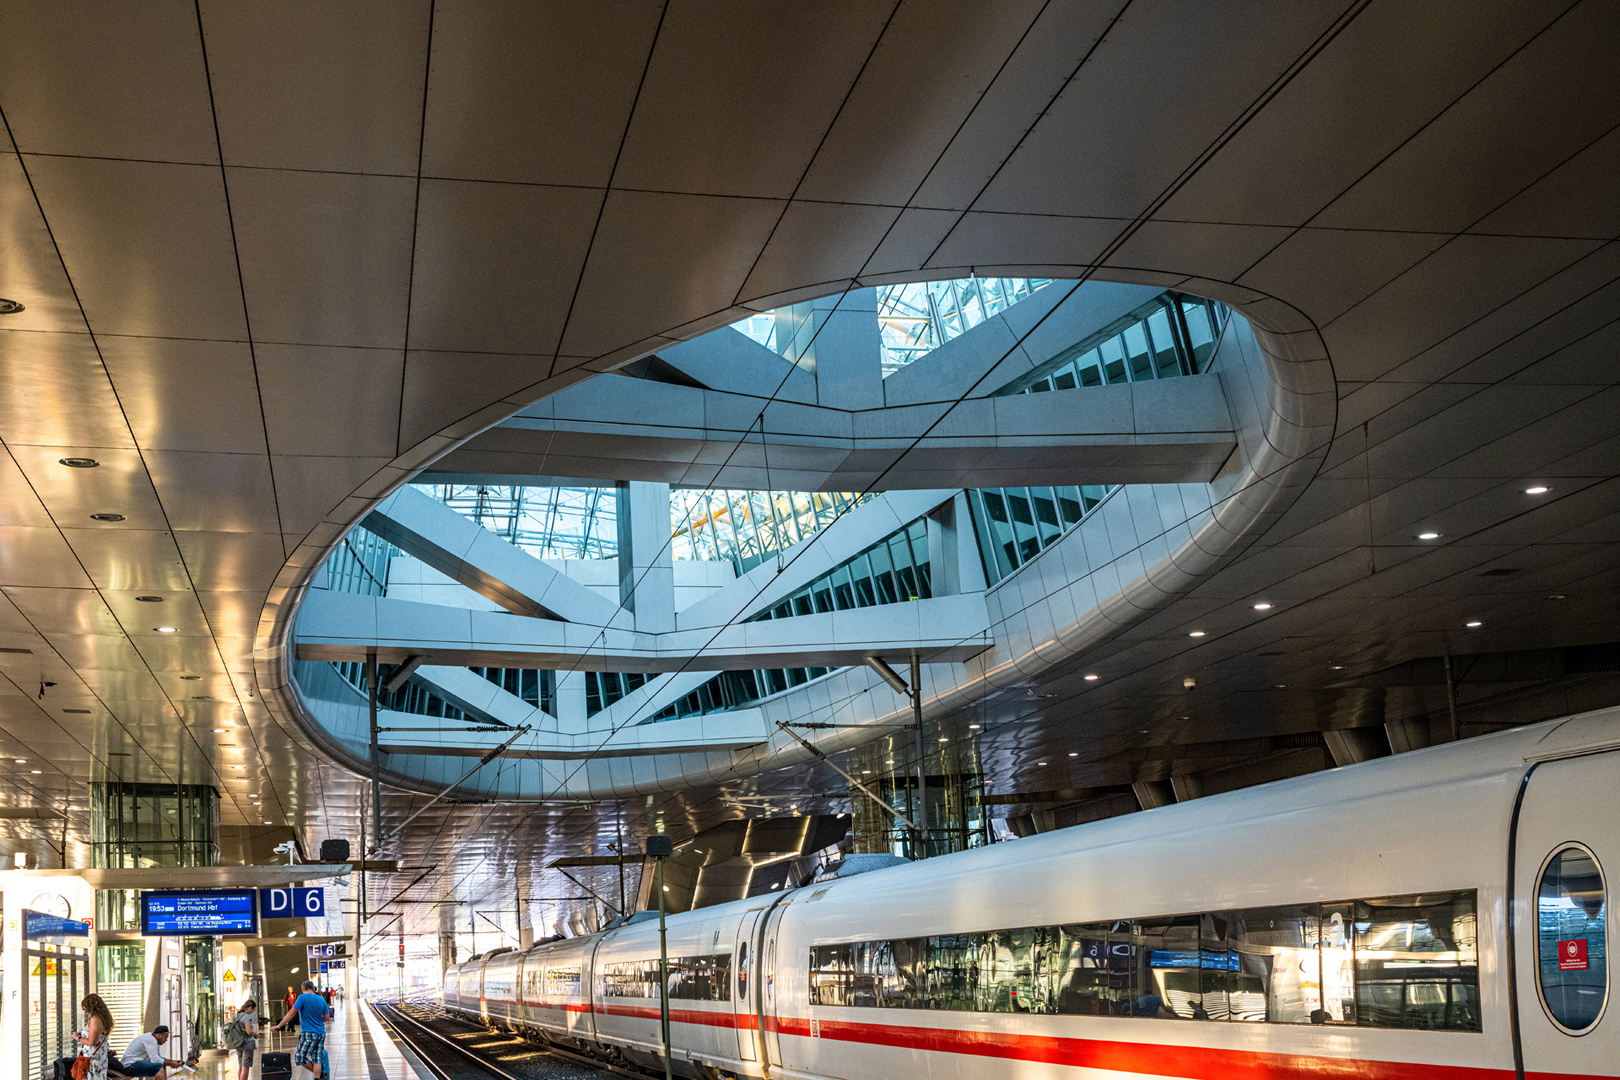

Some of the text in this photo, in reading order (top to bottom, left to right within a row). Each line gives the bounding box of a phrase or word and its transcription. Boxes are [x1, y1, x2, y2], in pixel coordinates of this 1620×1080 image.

[270, 889, 321, 912] D 6
[312, 945, 333, 956] E 6
[12, 990, 17, 999] F
